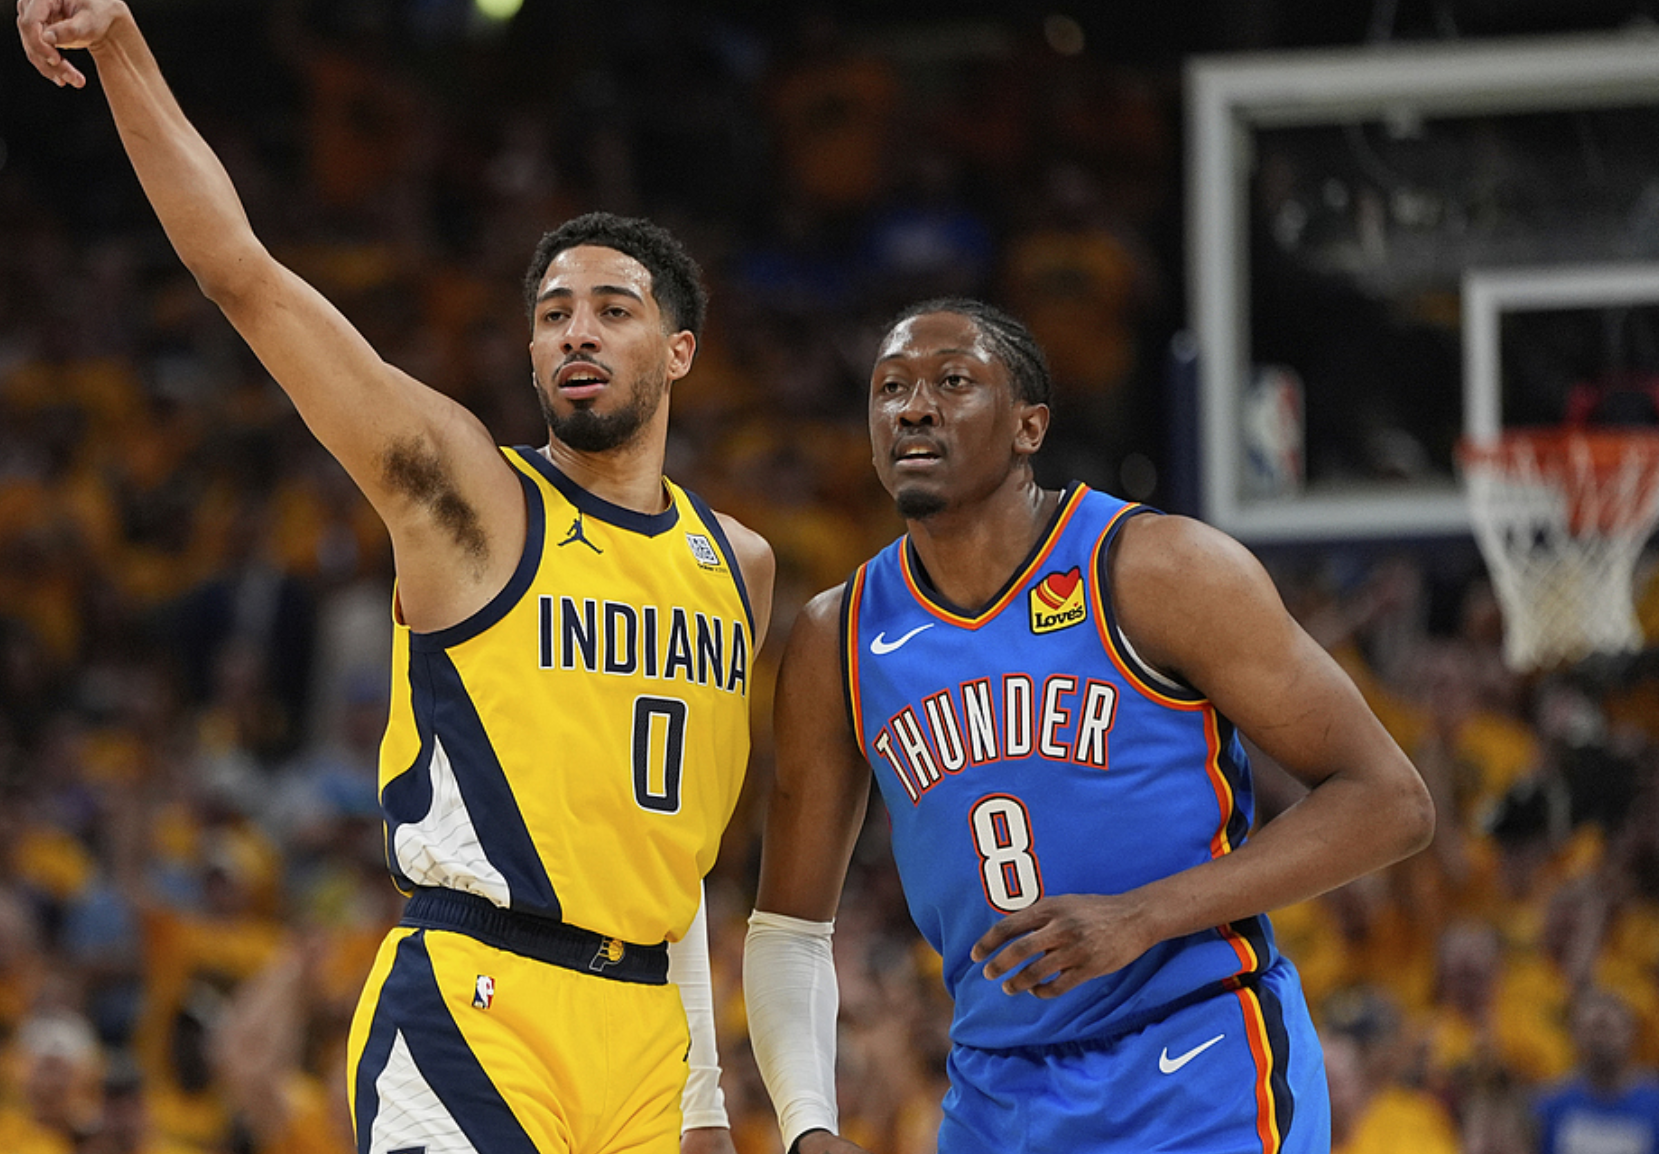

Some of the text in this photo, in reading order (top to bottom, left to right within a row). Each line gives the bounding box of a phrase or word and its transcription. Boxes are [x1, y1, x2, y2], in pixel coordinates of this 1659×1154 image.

[538, 594, 748, 697] INDIANA
[632, 694, 688, 815] 0
[873, 673, 1118, 807] THUNDER
[968, 793, 1044, 914] 8
